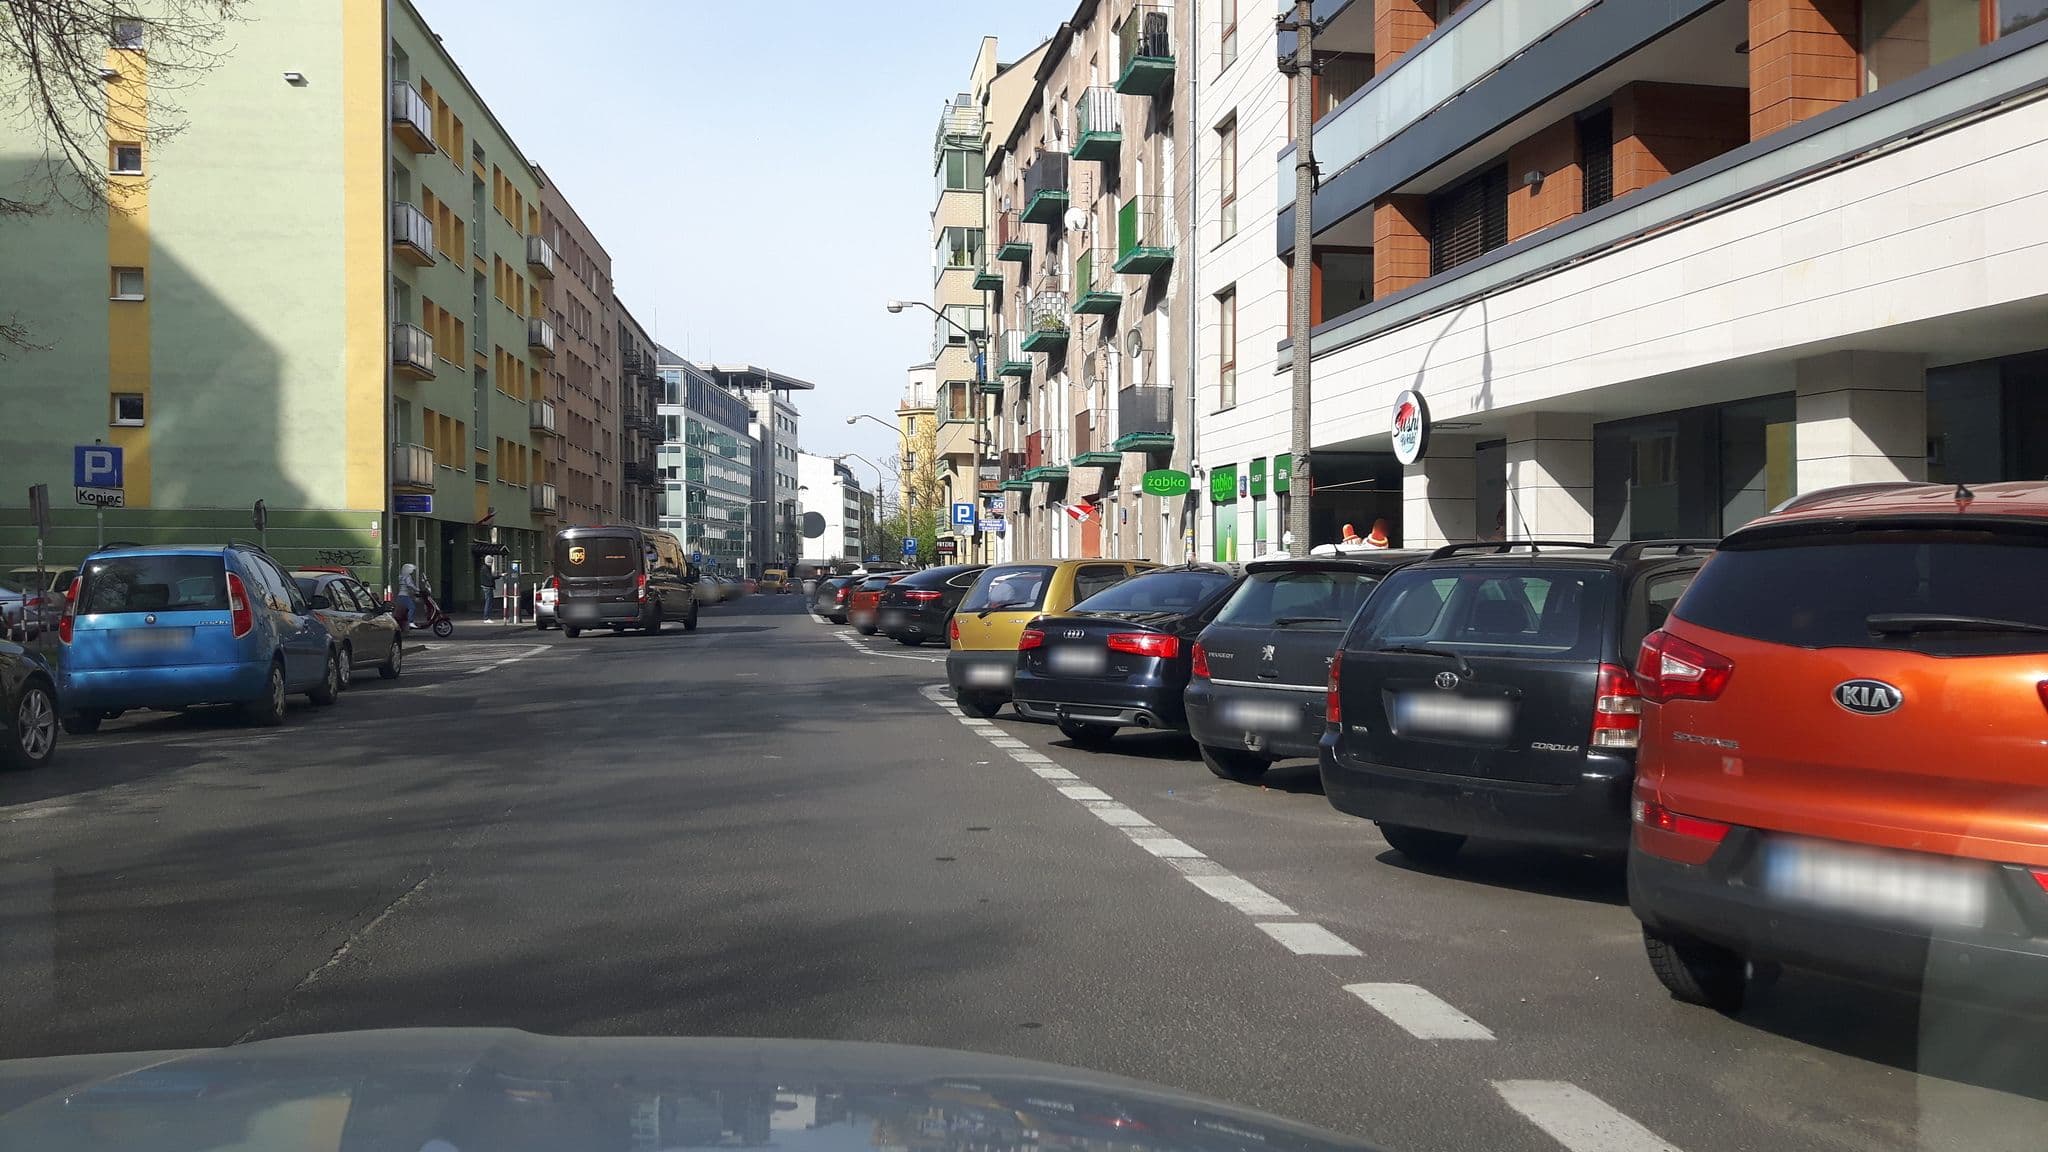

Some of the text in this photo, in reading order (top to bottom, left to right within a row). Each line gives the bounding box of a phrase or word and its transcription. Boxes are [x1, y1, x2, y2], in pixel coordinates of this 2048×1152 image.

[1394, 403, 1420, 437] Sushi
[85, 451, 112, 482] P
[1148, 476, 1185, 487] żabka
[1212, 473, 1232, 492] żabka
[79, 490, 122, 503] Koniec
[957, 505, 970, 522] P
[906, 540, 914, 550] P
[1842, 685, 1891, 708] KIA
[1531, 741, 1579, 752] COROLLA
